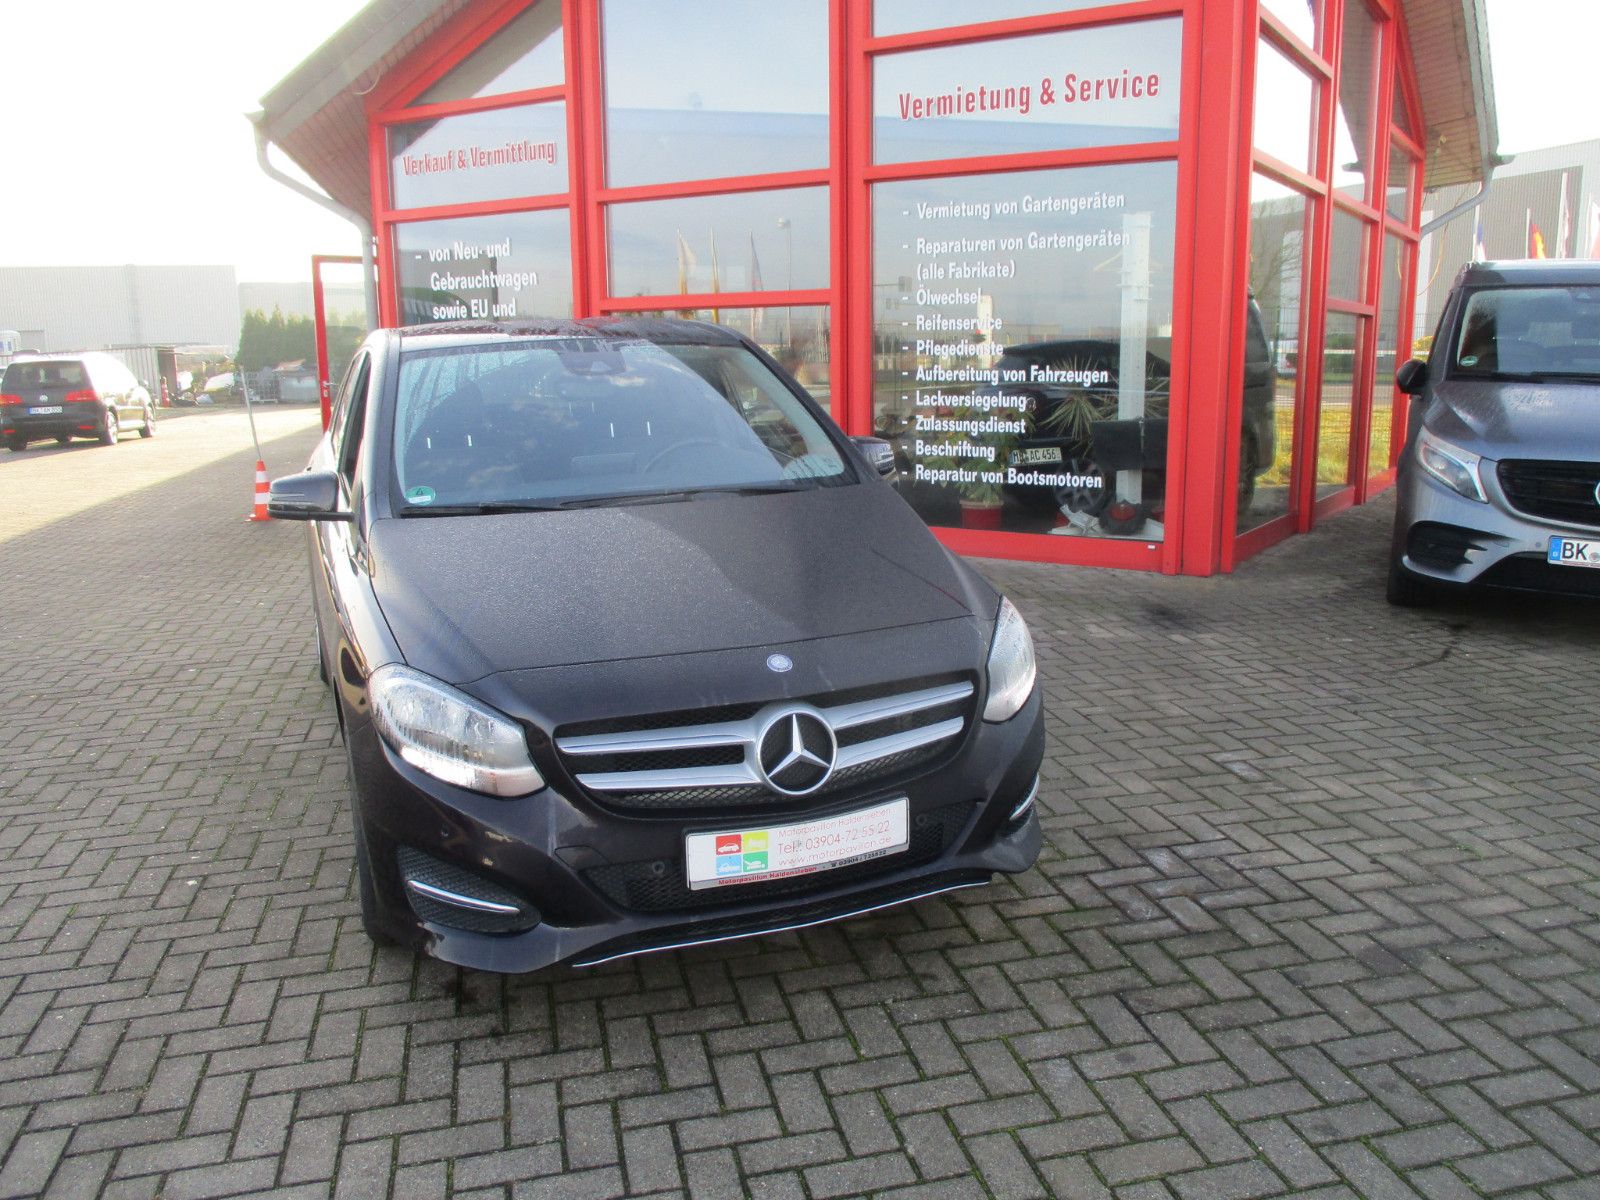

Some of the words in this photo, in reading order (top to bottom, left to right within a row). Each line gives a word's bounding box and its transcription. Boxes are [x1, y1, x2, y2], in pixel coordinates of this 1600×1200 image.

[899, 85, 1031, 120] Vermietung
[1040, 78, 1055, 105] &
[1064, 69, 1160, 103] Service
[403, 150, 453, 176] Verkauf
[457, 149, 467, 169] &
[470, 140, 557, 168] Vermittlung
[917, 202, 990, 220] Vermietung
[995, 203, 1018, 215] von
[1022, 192, 1125, 215] Gartengeräten
[429, 248, 450, 262] von
[454, 241, 483, 260] Neu-
[487, 237, 510, 258] und
[917, 236, 996, 255] Reparaturen
[1000, 236, 1024, 250] von
[1027, 229, 1130, 252] Gartengeräten
[430, 269, 538, 292] Gebrauchtwagen
[916, 263, 945, 280] (alle
[949, 260, 1016, 279] Fabrikate)
[916, 284, 982, 306] Ölwechsel
[432, 300, 468, 320] sowie
[471, 299, 489, 318] EU
[492, 298, 517, 317] und
[916, 313, 1003, 331] Reifenservice
[916, 339, 1004, 358] Pflegedienste
[915, 364, 999, 386] Aufbereitung
[1003, 368, 1026, 382] von
[1030, 365, 1109, 387] Fahrzeugen
[915, 390, 1027, 412] Lackversiegelung
[915, 414, 1026, 436] Zulassungsdienst
[915, 439, 996, 462] Beschriftung
[915, 464, 978, 485] Reparatur
[981, 471, 1003, 485] von
[1007, 468, 1102, 489] Bootsmotoren
[1562, 541, 1589, 561] BK
